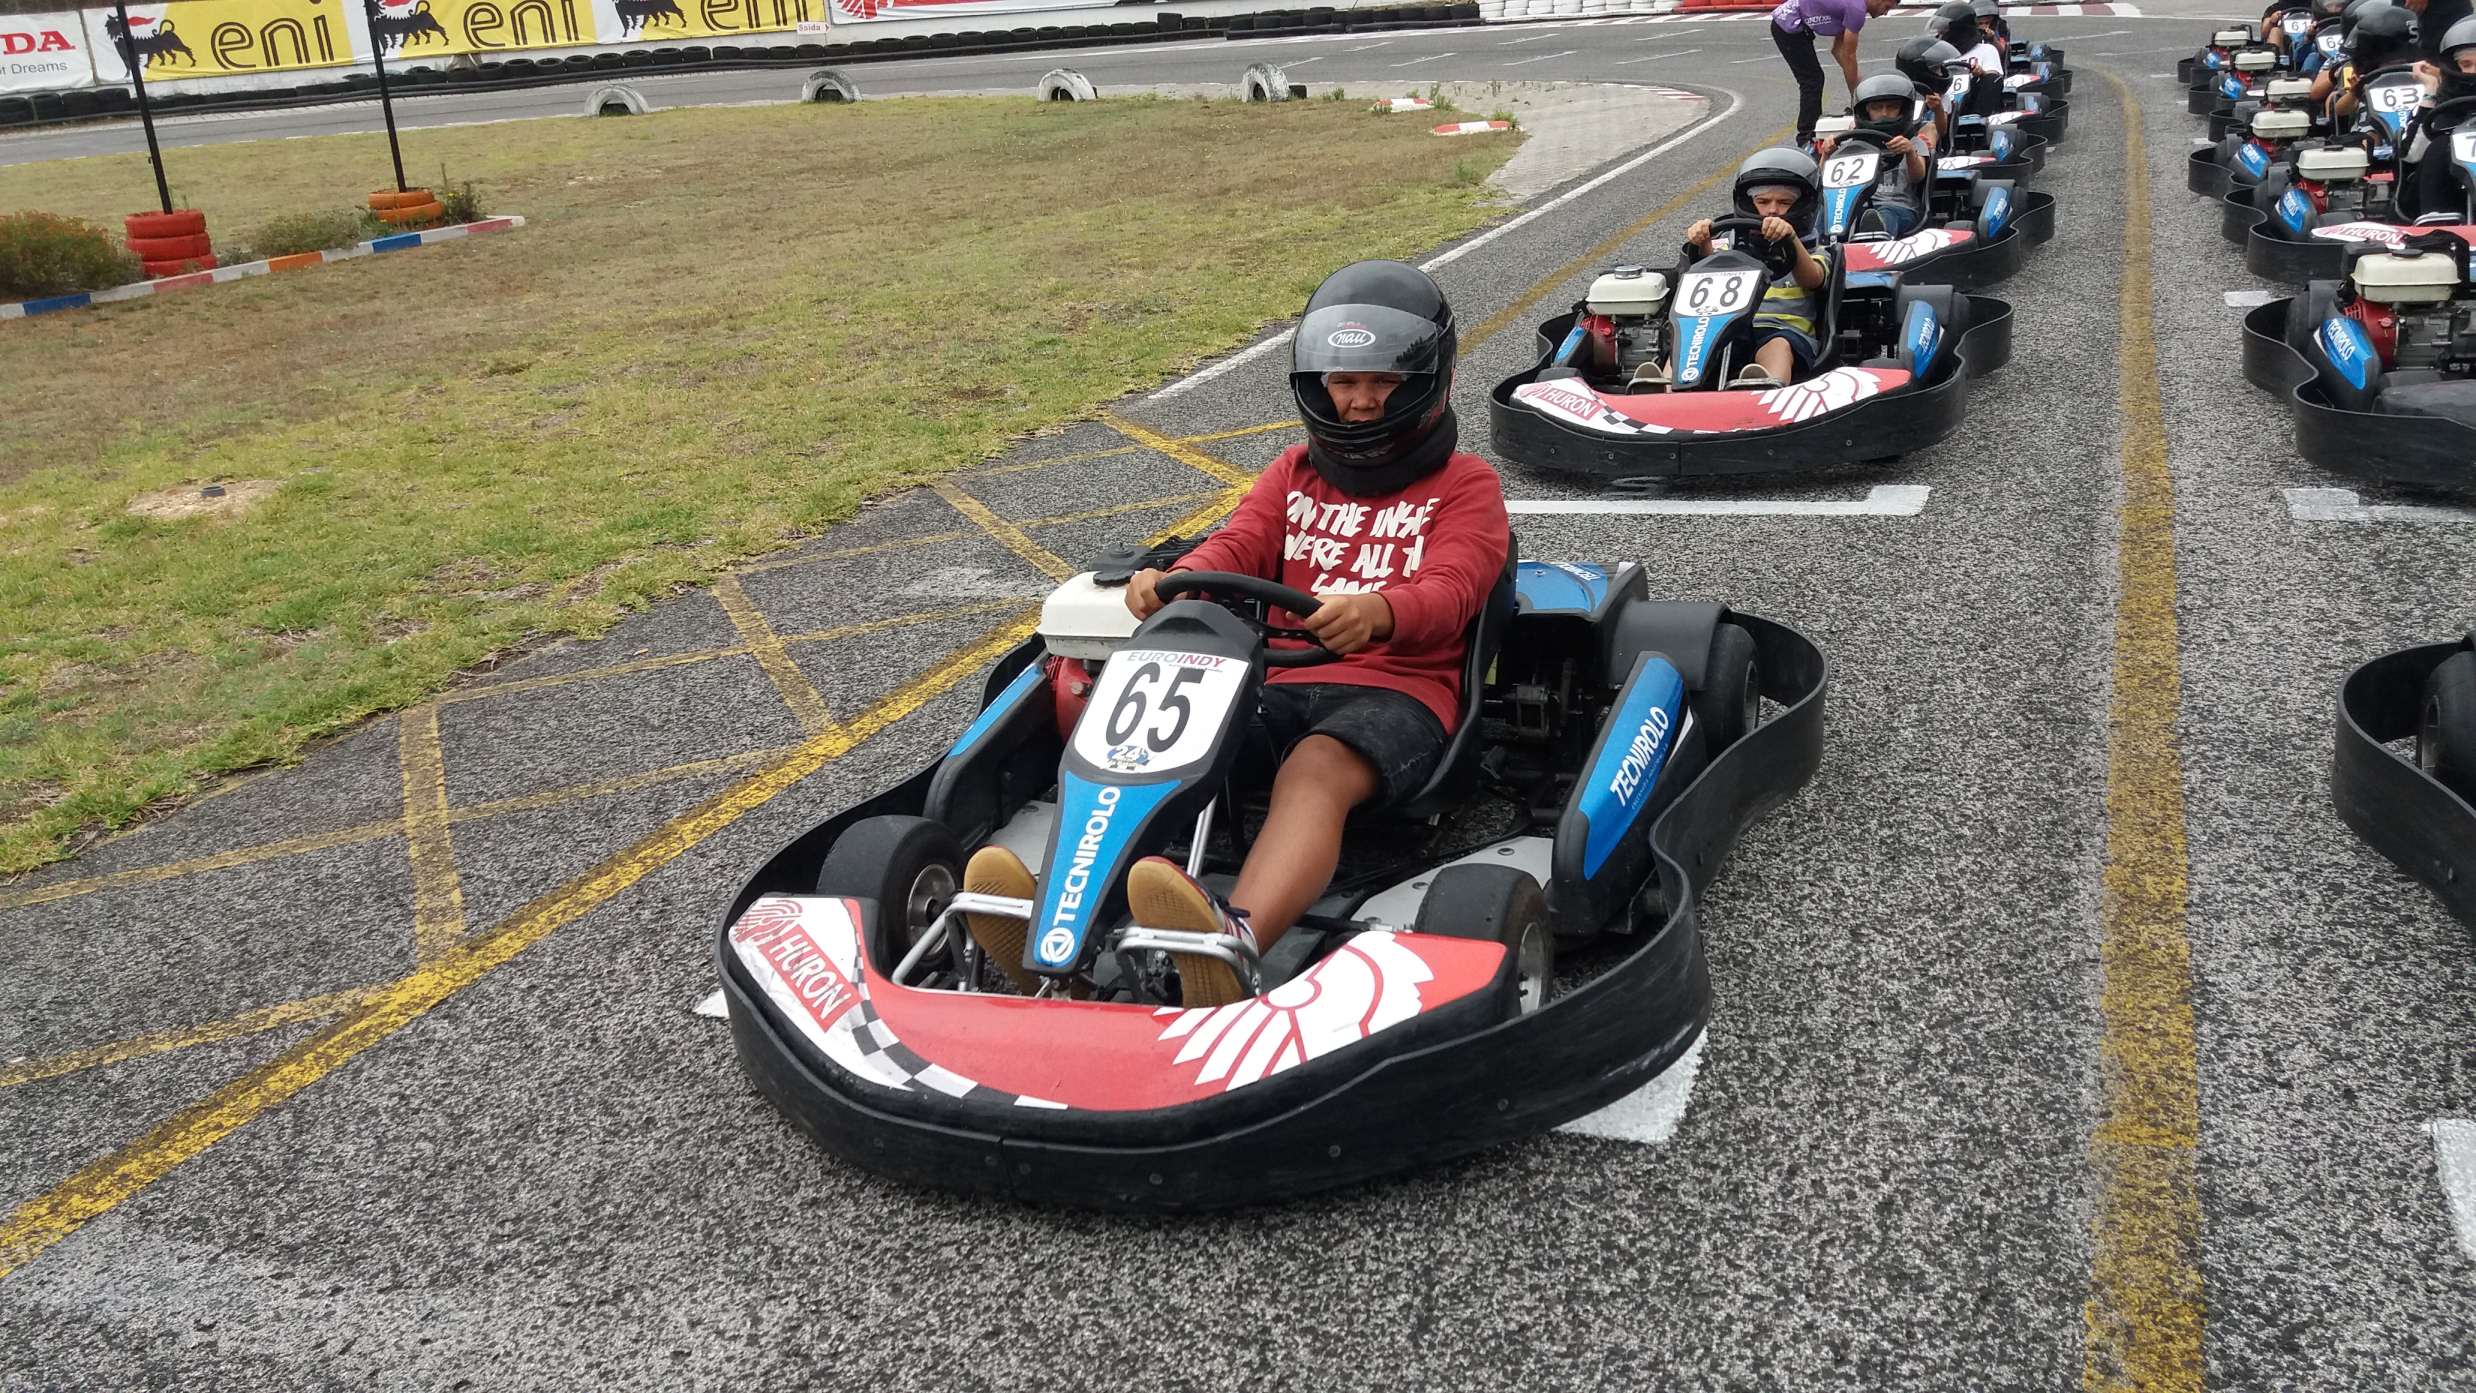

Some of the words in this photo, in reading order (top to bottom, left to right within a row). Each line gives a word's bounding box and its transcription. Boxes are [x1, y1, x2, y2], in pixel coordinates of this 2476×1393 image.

[463, 0, 580, 48] eni
[701, 0, 809, 33] eni
[211, 0, 335, 69] eni
[11, 62, 68, 74] Dreams
[2383, 87, 2420, 107] 63
[1831, 158, 1865, 182] 62
[1689, 276, 1742, 308] 68
[1687, 316, 1710, 368] TECNIROLO
[1546, 388, 1598, 417] HURON
[1317, 502, 1371, 537] THE
[1350, 543, 1394, 579] ALL
[1127, 651, 1227, 668] EUROINDY
[1105, 662, 1206, 752] 65
[1610, 706, 1670, 808] TECNIROLO
[1053, 786, 1121, 926] TECNIROLO
[769, 933, 852, 1020] HURON
